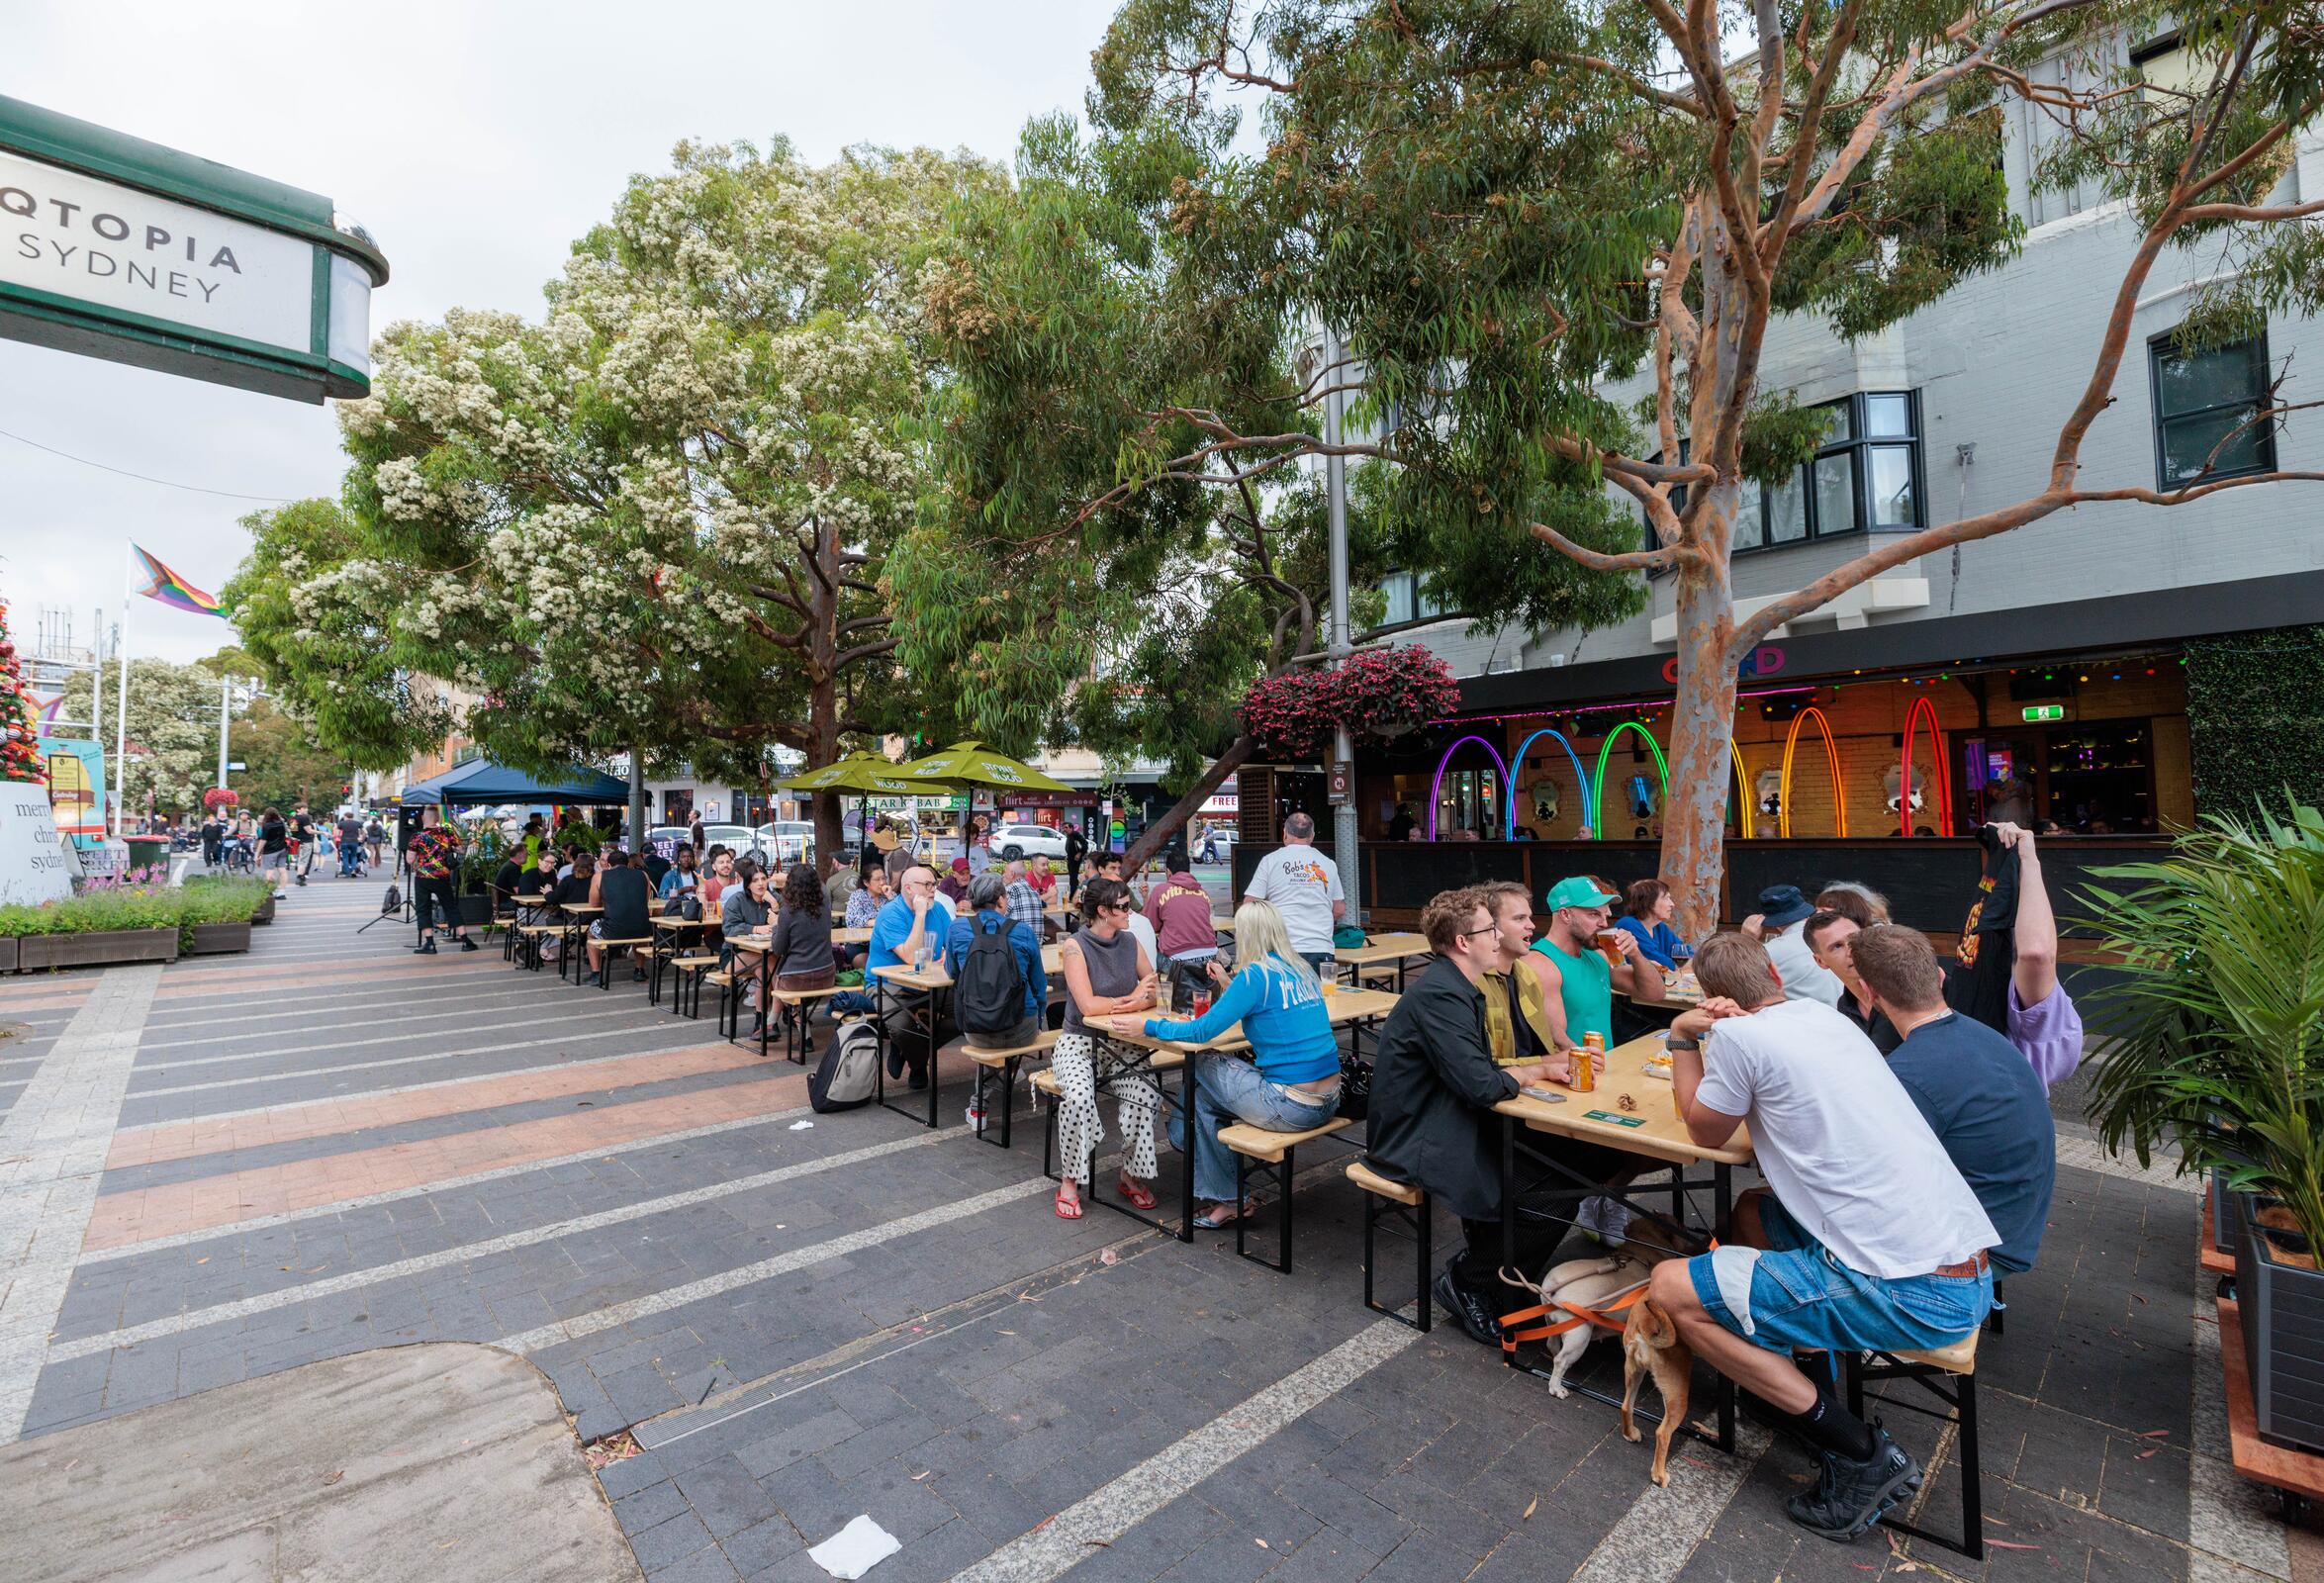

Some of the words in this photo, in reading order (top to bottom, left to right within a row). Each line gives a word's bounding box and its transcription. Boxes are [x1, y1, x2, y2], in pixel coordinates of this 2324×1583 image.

[0, 187, 242, 275] QTOPIA
[18, 233, 221, 303] SYDNEY
[867, 798, 896, 808] STAR
[900, 798, 941, 807] KBAB
[1005, 795, 1023, 805] flirt
[1212, 796, 1237, 806] FREE
[1282, 860, 1305, 875] Bob's
